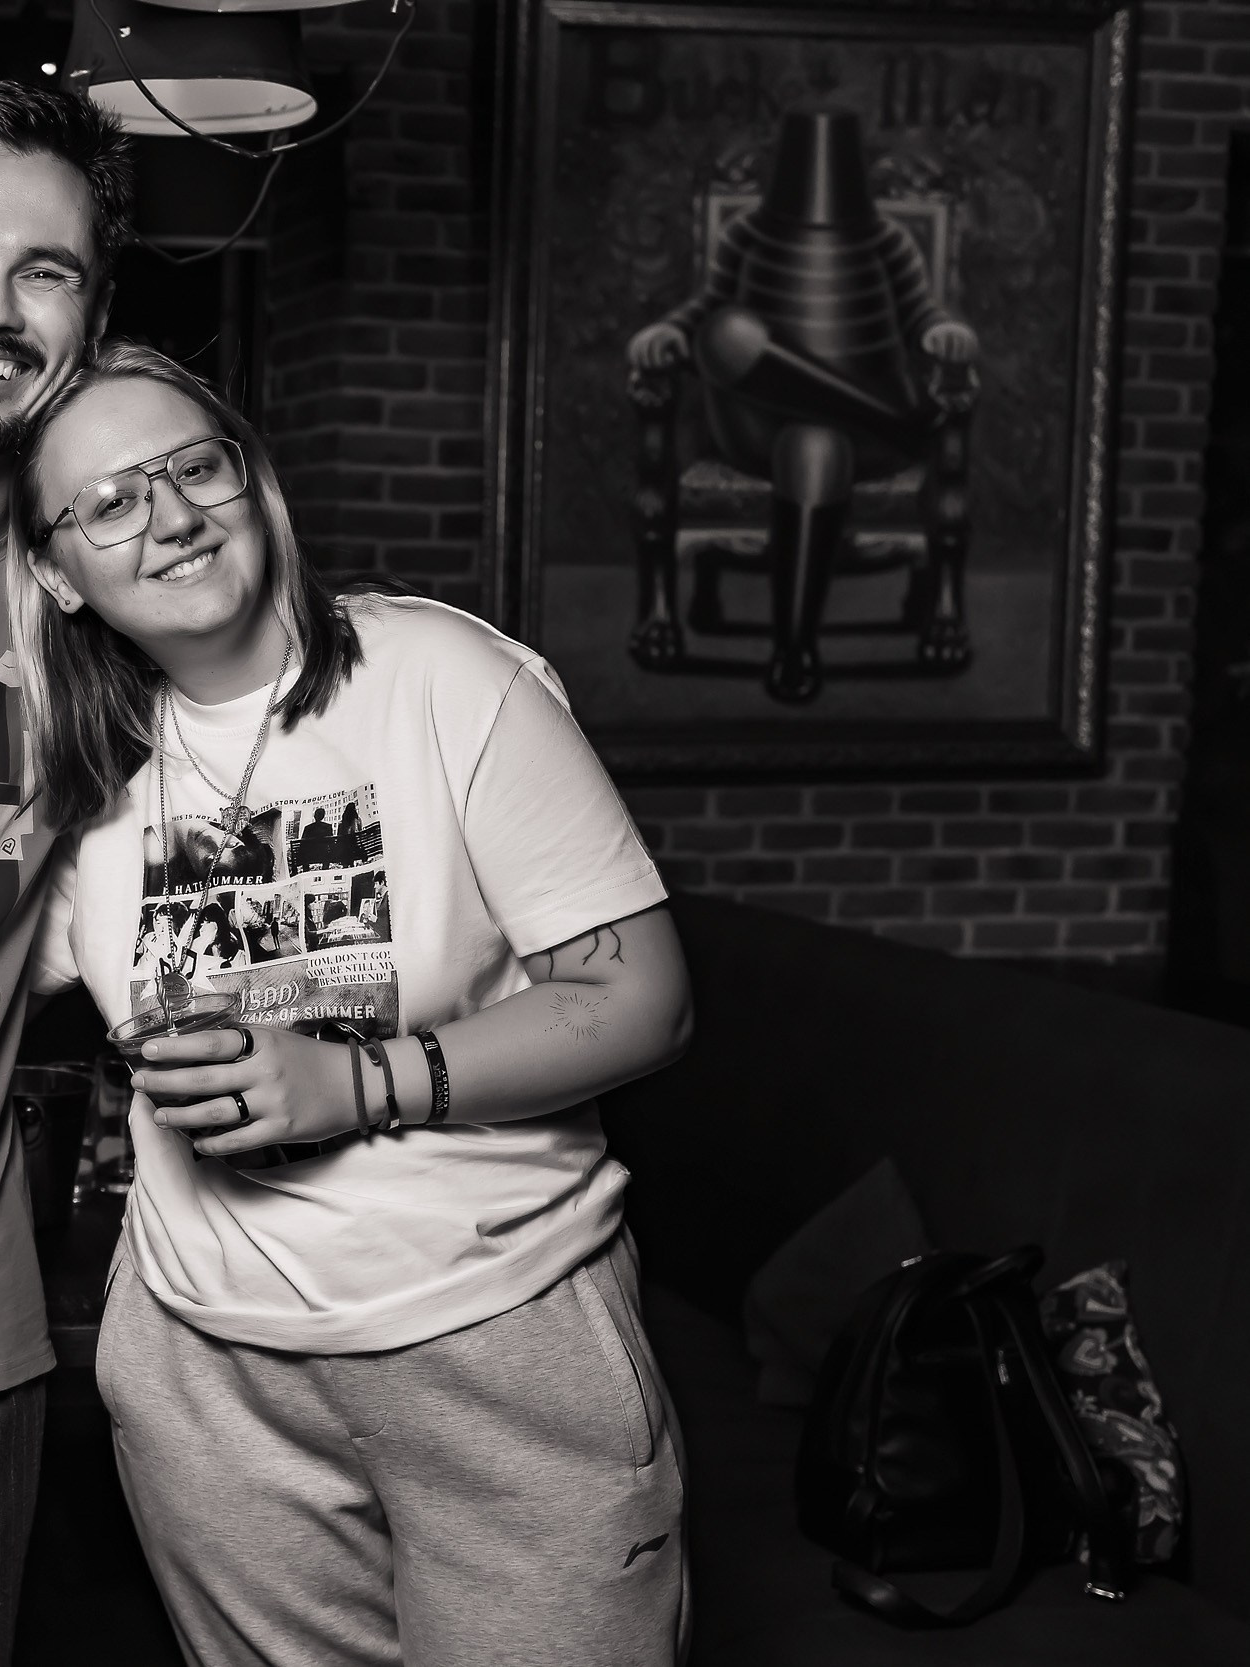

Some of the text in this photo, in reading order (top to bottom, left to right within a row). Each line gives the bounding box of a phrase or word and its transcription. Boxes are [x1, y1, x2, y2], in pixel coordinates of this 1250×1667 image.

[274, 799, 299, 807] STORY
[302, 794, 327, 804] ABOUT
[175, 880, 204, 895] HATE
[370, 950, 391, 960] GO!
[345, 962, 377, 973] STILL
[379, 961, 396, 970] MY
[319, 972, 387, 987] BEST FRIEND!
[239, 1004, 376, 1023] DAYS OF SUMMER
